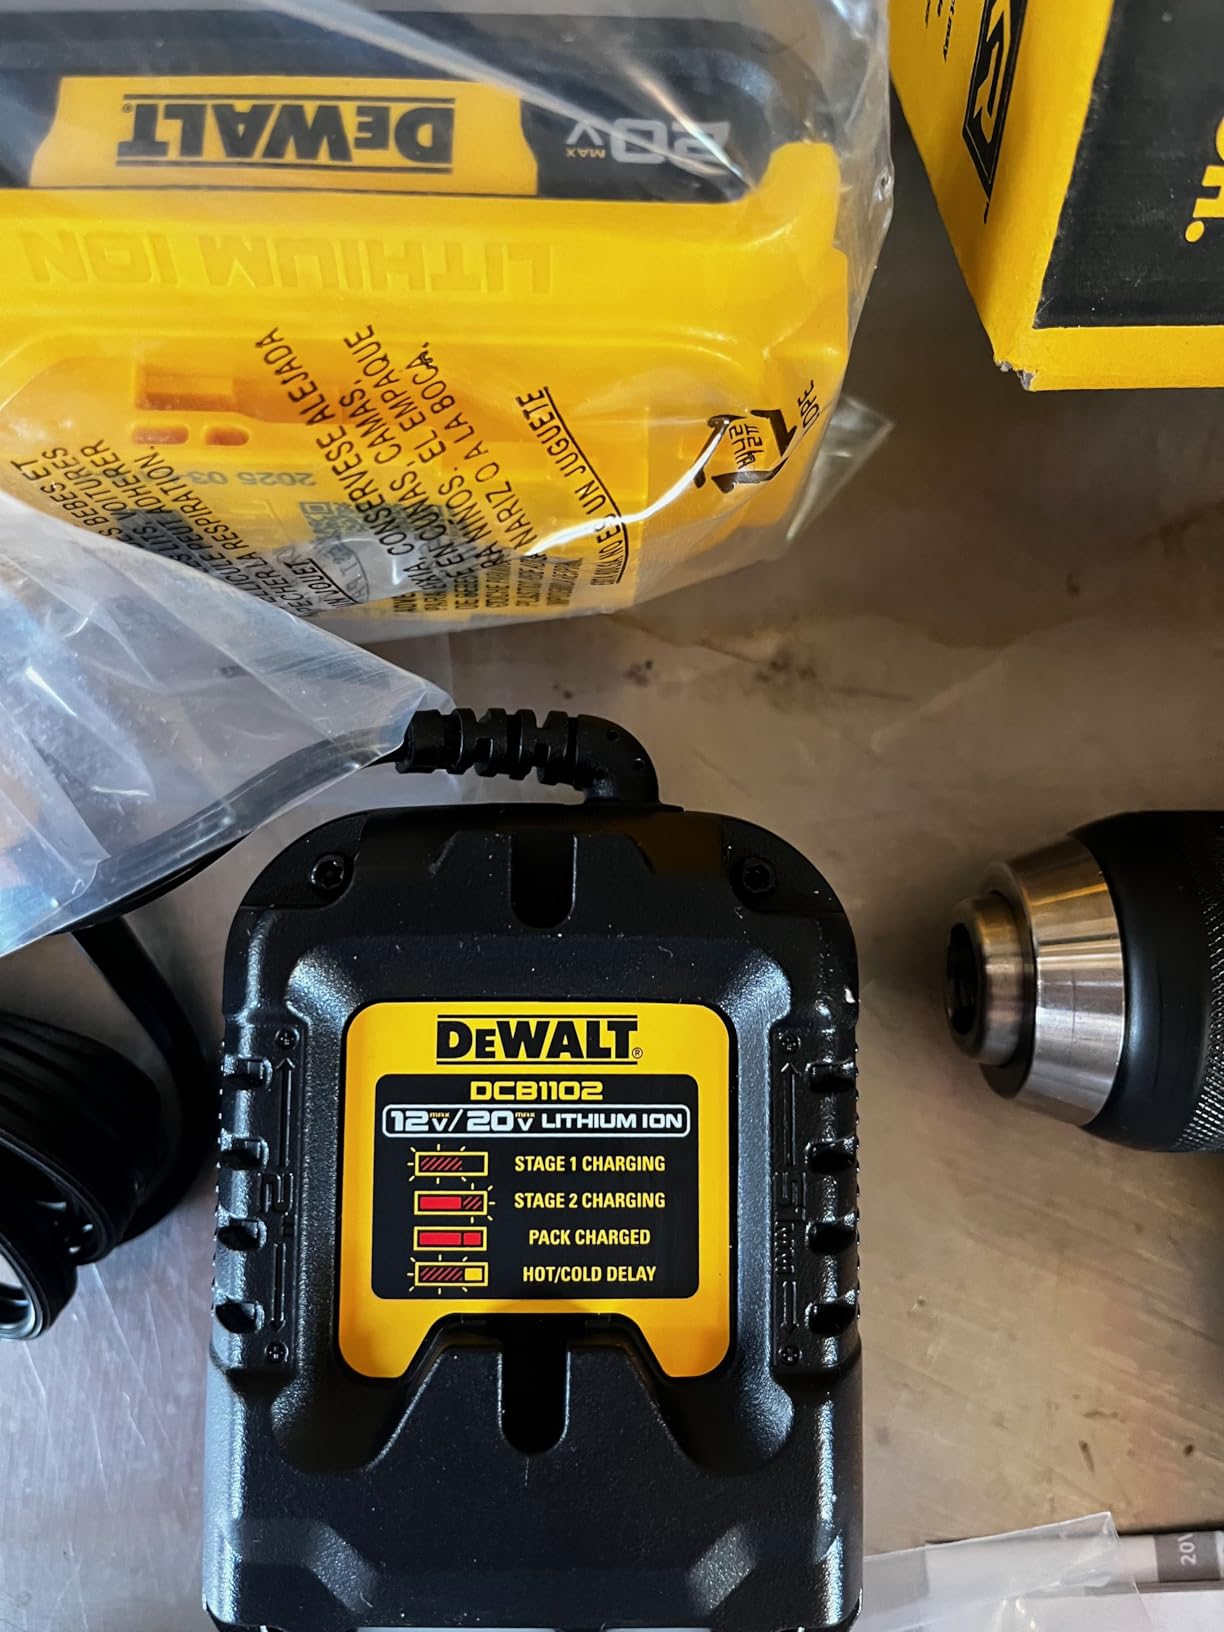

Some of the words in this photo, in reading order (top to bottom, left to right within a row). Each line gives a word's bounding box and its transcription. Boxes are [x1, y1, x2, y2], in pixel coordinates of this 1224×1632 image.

[565, 147, 606, 159] MAX
[17, 231, 182, 285] ION
[196, 232, 553, 294] LITHIUM
[255, 327, 336, 425] ALEJADA
[344, 325, 427, 432] EMPAQUE
[338, 379, 402, 464] CAMAS,
[444, 412, 475, 443] LA
[515, 389, 587, 477] JUGUETE
[414, 429, 446, 463] EL
[464, 440, 488, 460] A
[10, 459, 52, 481] ET
[42, 447, 138, 521] VOITURES
[80, 439, 172, 514] ADHERER
[236, 470, 316, 486] 2025
[475, 462, 499, 482] O
[40, 482, 110, 526] BEBES
[134, 446, 249, 551] RESPIRATION.
[316, 425, 415, 556] CONSERVESE
[389, 461, 447, 541] CUNAS,
[575, 480, 606, 515] UN
[485, 480, 537, 550] NARIZ
[158, 519, 213, 550] PEUT
[597, 538, 623, 561] NO
[236, 552, 268, 568] LA
[284, 558, 340, 595] JOUET
[470, 1081, 603, 1100] DCB1102
[541, 1112, 638, 1129] LITHIUM
[642, 1112, 682, 1129] ION
[514, 1155, 566, 1172] STAGE
[569, 1155, 577, 1172] 1
[582, 1155, 666, 1172] CHARGING
[514, 1192, 566, 1209] STAGE
[568, 1192, 578, 1209] 2
[581, 1192, 666, 1209] CHARGING
[528, 1229, 571, 1246] PACK
[575, 1229, 651, 1246] CHARGED
[522, 1266, 602, 1284] HOT/COLD
[607, 1266, 657, 1283] DELAY
